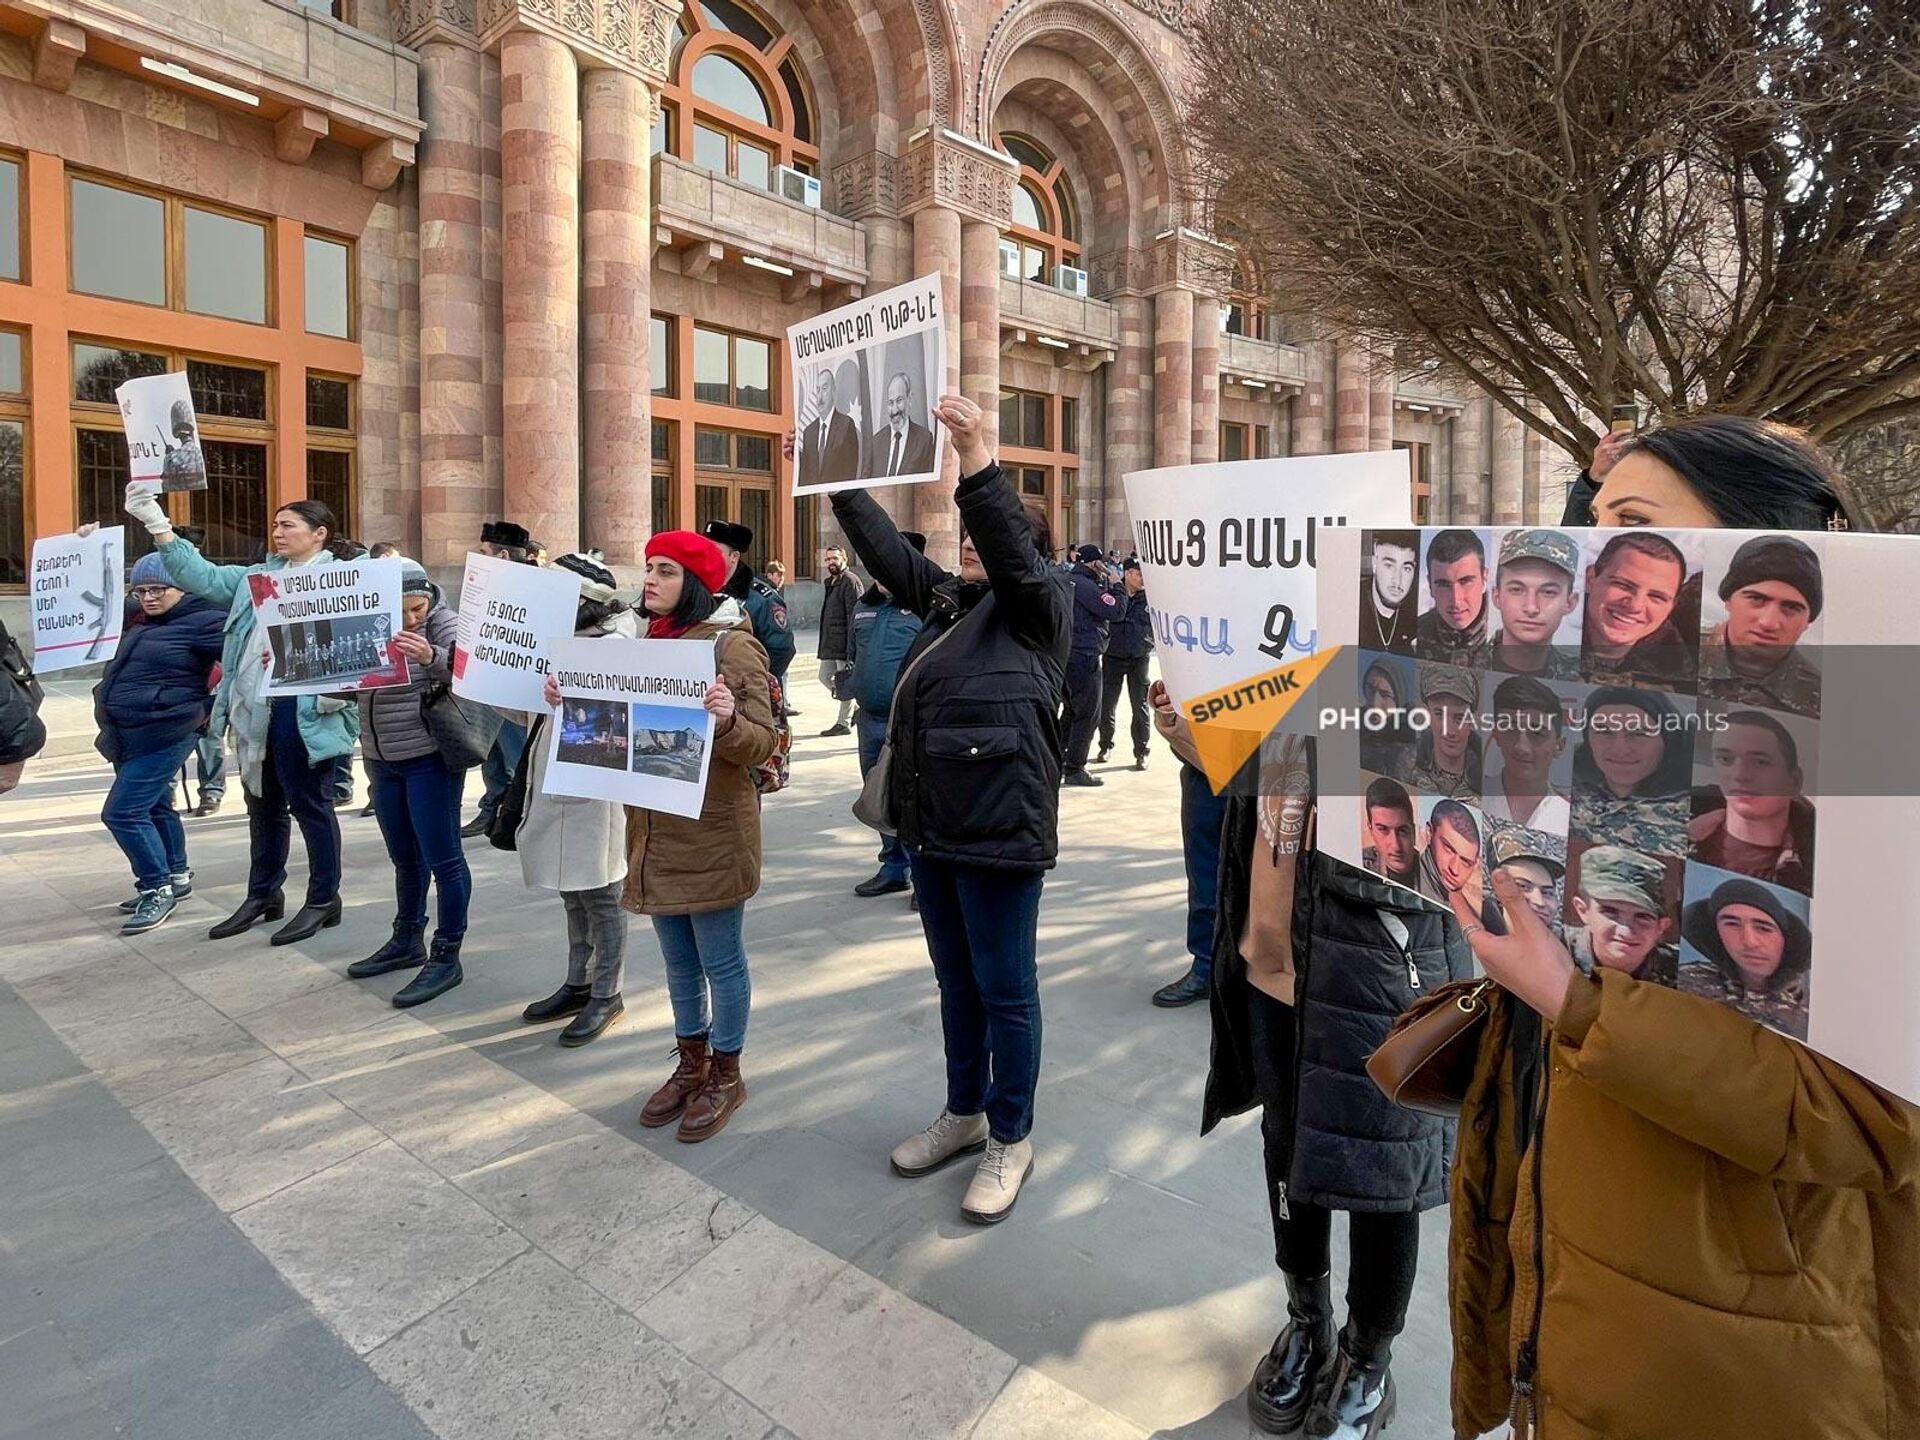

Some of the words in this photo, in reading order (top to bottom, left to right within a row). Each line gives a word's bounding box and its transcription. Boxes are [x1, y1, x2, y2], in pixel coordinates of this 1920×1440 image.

[795, 318, 854, 359] ՄԵՂԱՎՈՐԸ
[929, 291, 937, 319] Է
[1136, 518, 1206, 567] ԱՌԱՆՑ
[283, 574, 316, 594] ԱՐՅԱՆ
[319, 569, 360, 590] ՀԱՄԱՐ
[36, 596, 57, 611] ՄԵՐ
[278, 594, 359, 619] ՊԱՏԱՍԽԱՆԱՏՈՒ
[362, 592, 380, 610] ԵՔ
[486, 600, 498, 617] 15
[498, 603, 527, 624] ԶՈՀԸ
[38, 612, 85, 631] ԲԱՆԱԿԻՑ
[479, 622, 537, 650] ՀԵՐԹԱԿԱՆ
[475, 644, 533, 671] ՎԵՐՆԱԳԻՐ
[557, 670, 604, 690] ԶՈՒԳԱՀԵՌ
[605, 674, 707, 698] ԻՐԱԿԱՆՈՒԹՅՈՒՆՆԵՐ
